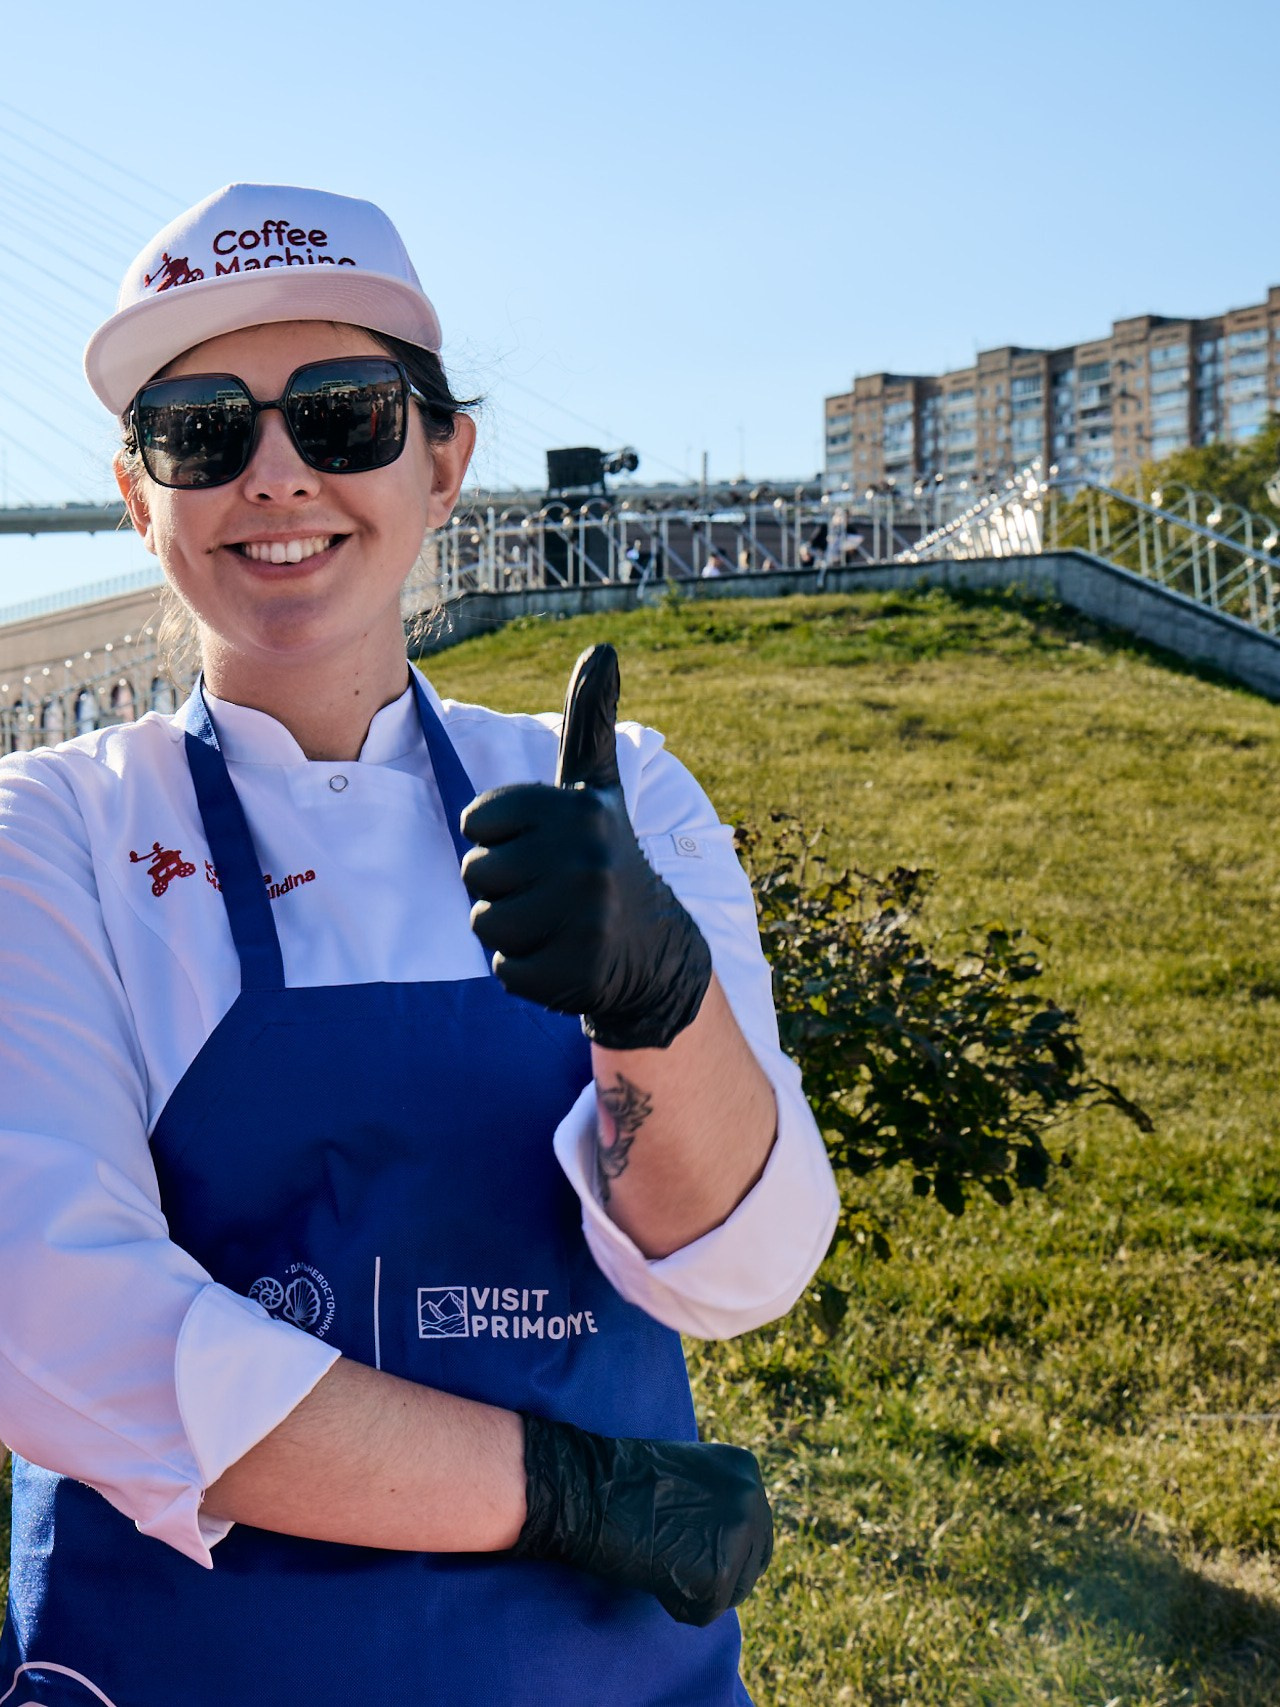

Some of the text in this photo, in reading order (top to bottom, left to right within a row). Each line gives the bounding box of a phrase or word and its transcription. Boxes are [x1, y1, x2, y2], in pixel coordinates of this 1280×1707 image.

[213, 219, 328, 255] Coffee
[470, 1286, 550, 1312] VISIT
[471, 1310, 599, 1340] PRIMOYE
